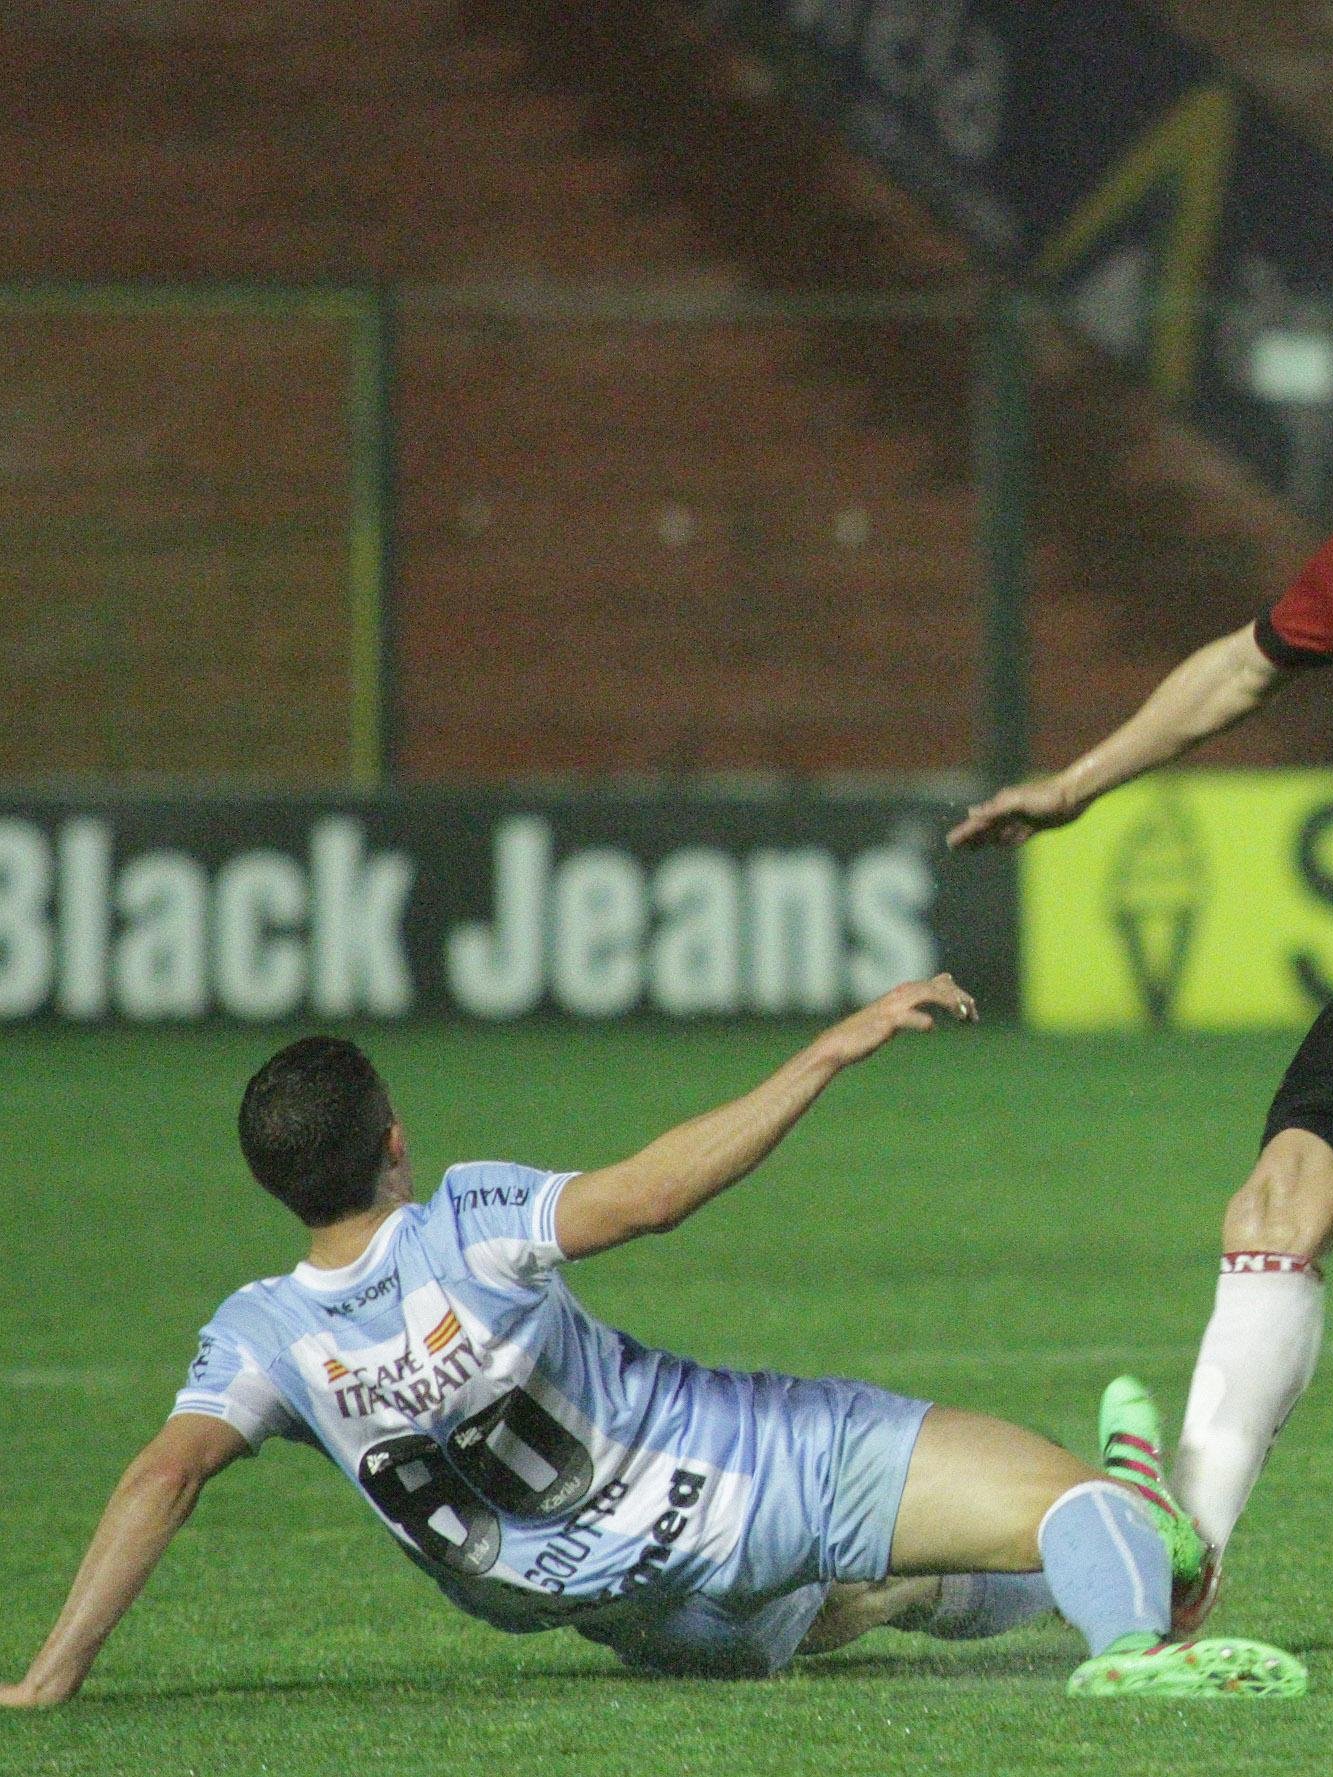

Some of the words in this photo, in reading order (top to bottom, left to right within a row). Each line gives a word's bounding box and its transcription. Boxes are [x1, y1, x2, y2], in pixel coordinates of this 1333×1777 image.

[0, 812, 412, 1018] Black
[446, 812, 938, 1018] Jeans
[334, 1336, 483, 1419] ITAARATY
